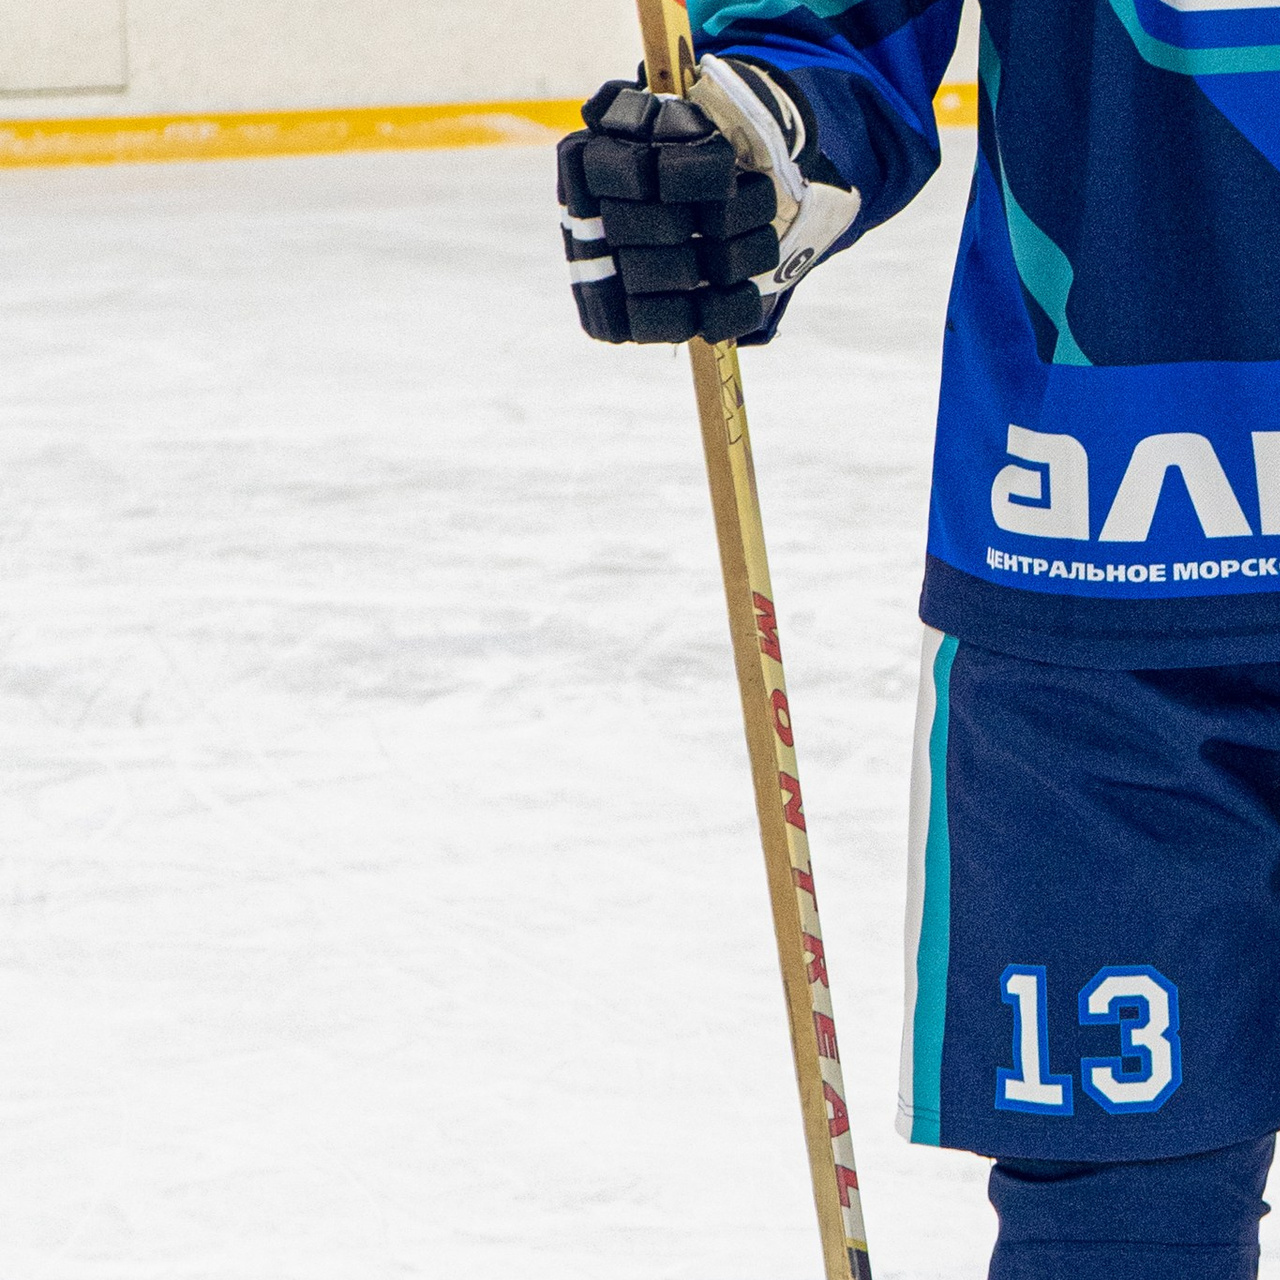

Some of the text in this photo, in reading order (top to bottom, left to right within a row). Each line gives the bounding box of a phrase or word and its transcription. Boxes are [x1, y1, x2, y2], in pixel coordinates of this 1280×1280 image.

[986, 546, 1167, 582] ЦЕНТРАЛЬНОЕ
[753, 590, 859, 1208] MONTREAL
[997, 966, 1181, 1114] 13
